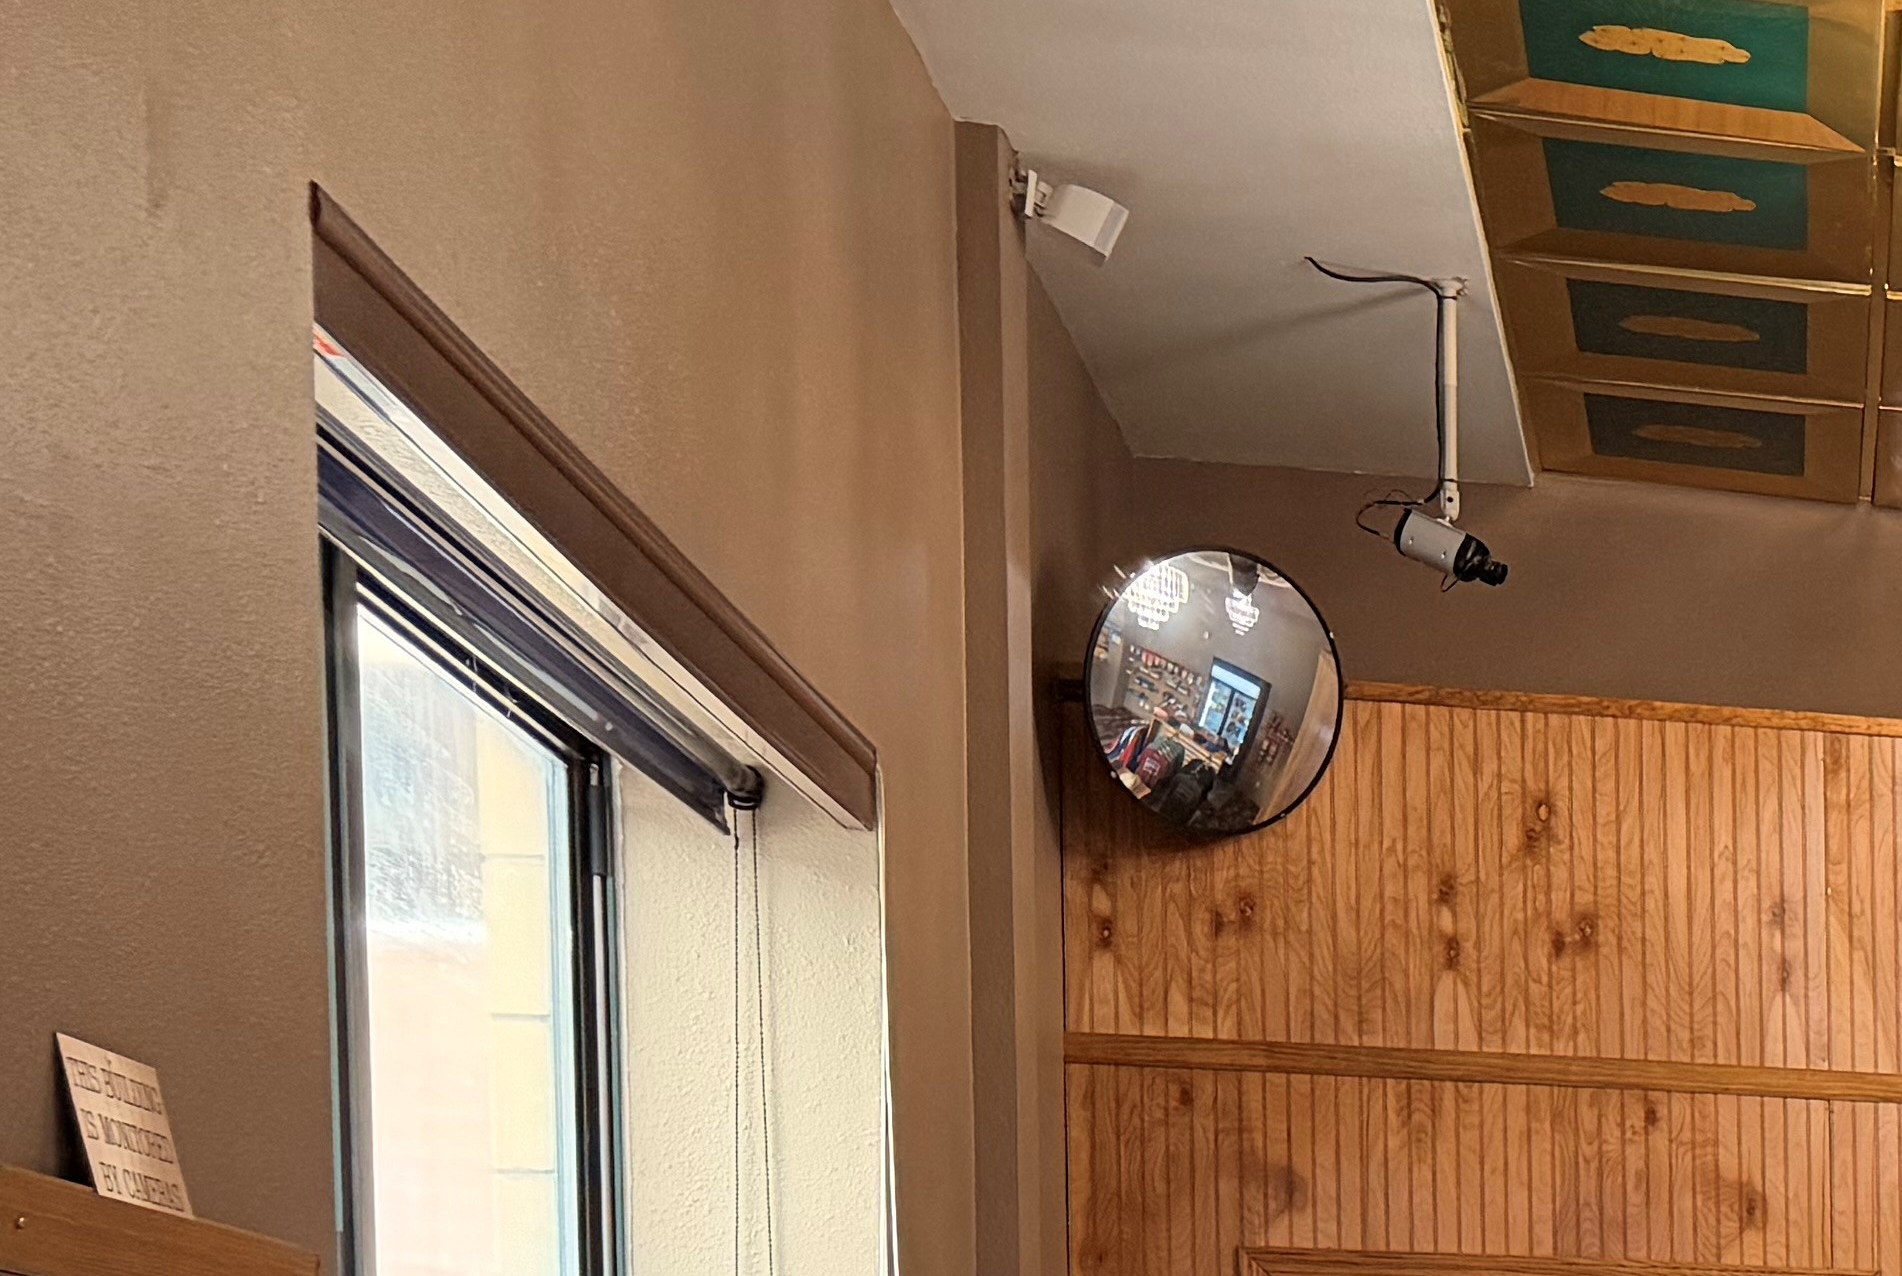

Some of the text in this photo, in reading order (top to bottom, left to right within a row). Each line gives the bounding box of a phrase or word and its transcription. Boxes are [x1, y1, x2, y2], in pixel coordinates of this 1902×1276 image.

[66, 1056, 164, 1116] THIS BUILDING
[80, 1108, 174, 1164] IS MONITORED
[99, 1161, 186, 1212] BY CAMERAS
